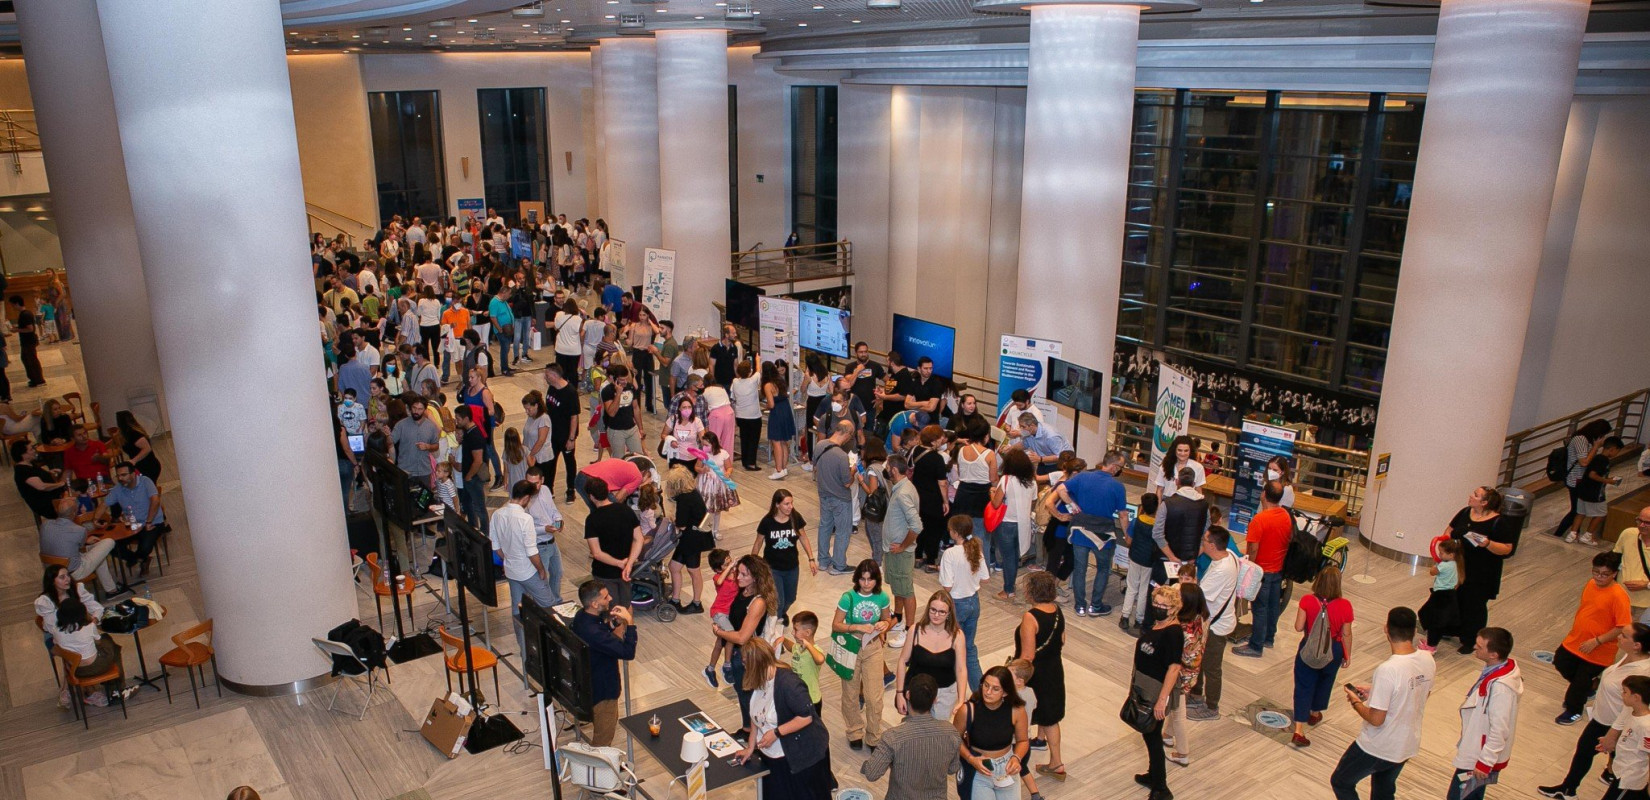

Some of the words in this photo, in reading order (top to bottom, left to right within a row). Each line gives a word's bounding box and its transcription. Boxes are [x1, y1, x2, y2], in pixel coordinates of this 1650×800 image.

[1170, 393, 1186, 411] MED
[1170, 405, 1185, 422] WAY
[1168, 416, 1183, 432] CAP
